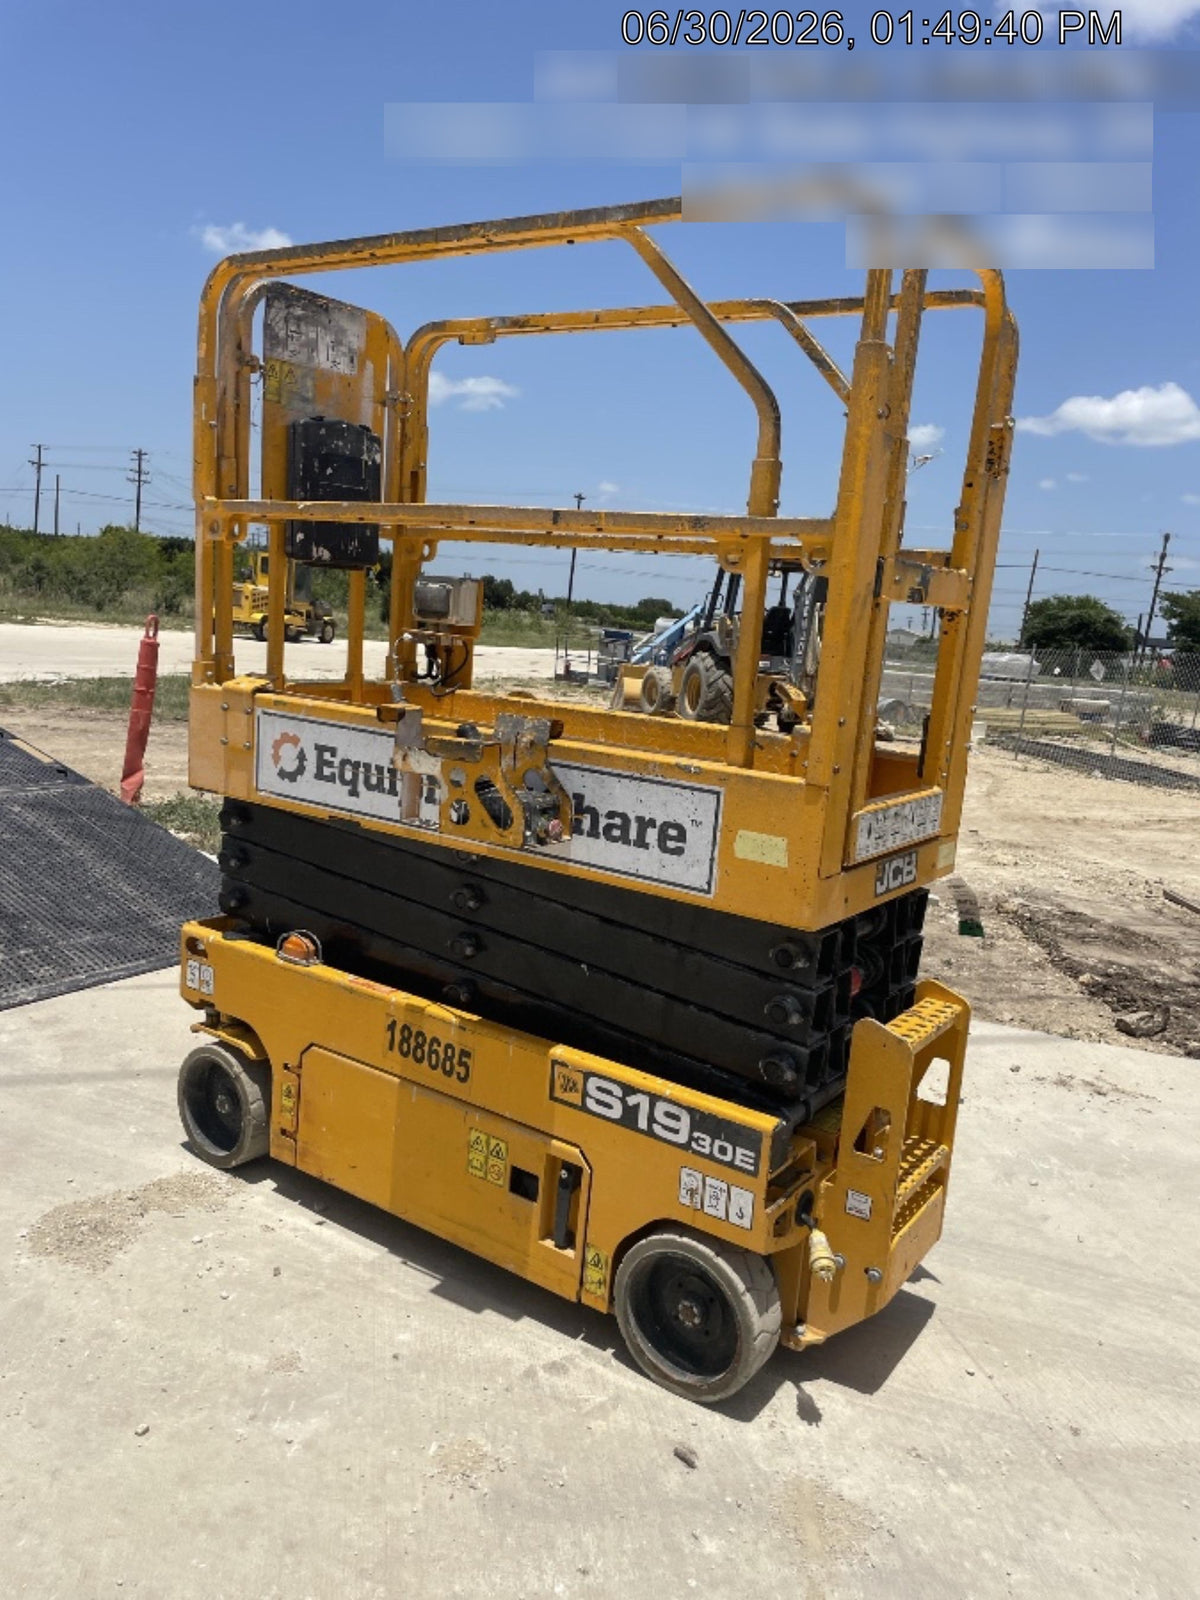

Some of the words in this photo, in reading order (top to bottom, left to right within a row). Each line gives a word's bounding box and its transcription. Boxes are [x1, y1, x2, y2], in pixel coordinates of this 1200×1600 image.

[876, 852, 917, 895] JCB
[387, 1018, 472, 1083] 188685
[585, 1076, 691, 1145] S19
[690, 1131, 755, 1171] 30E
